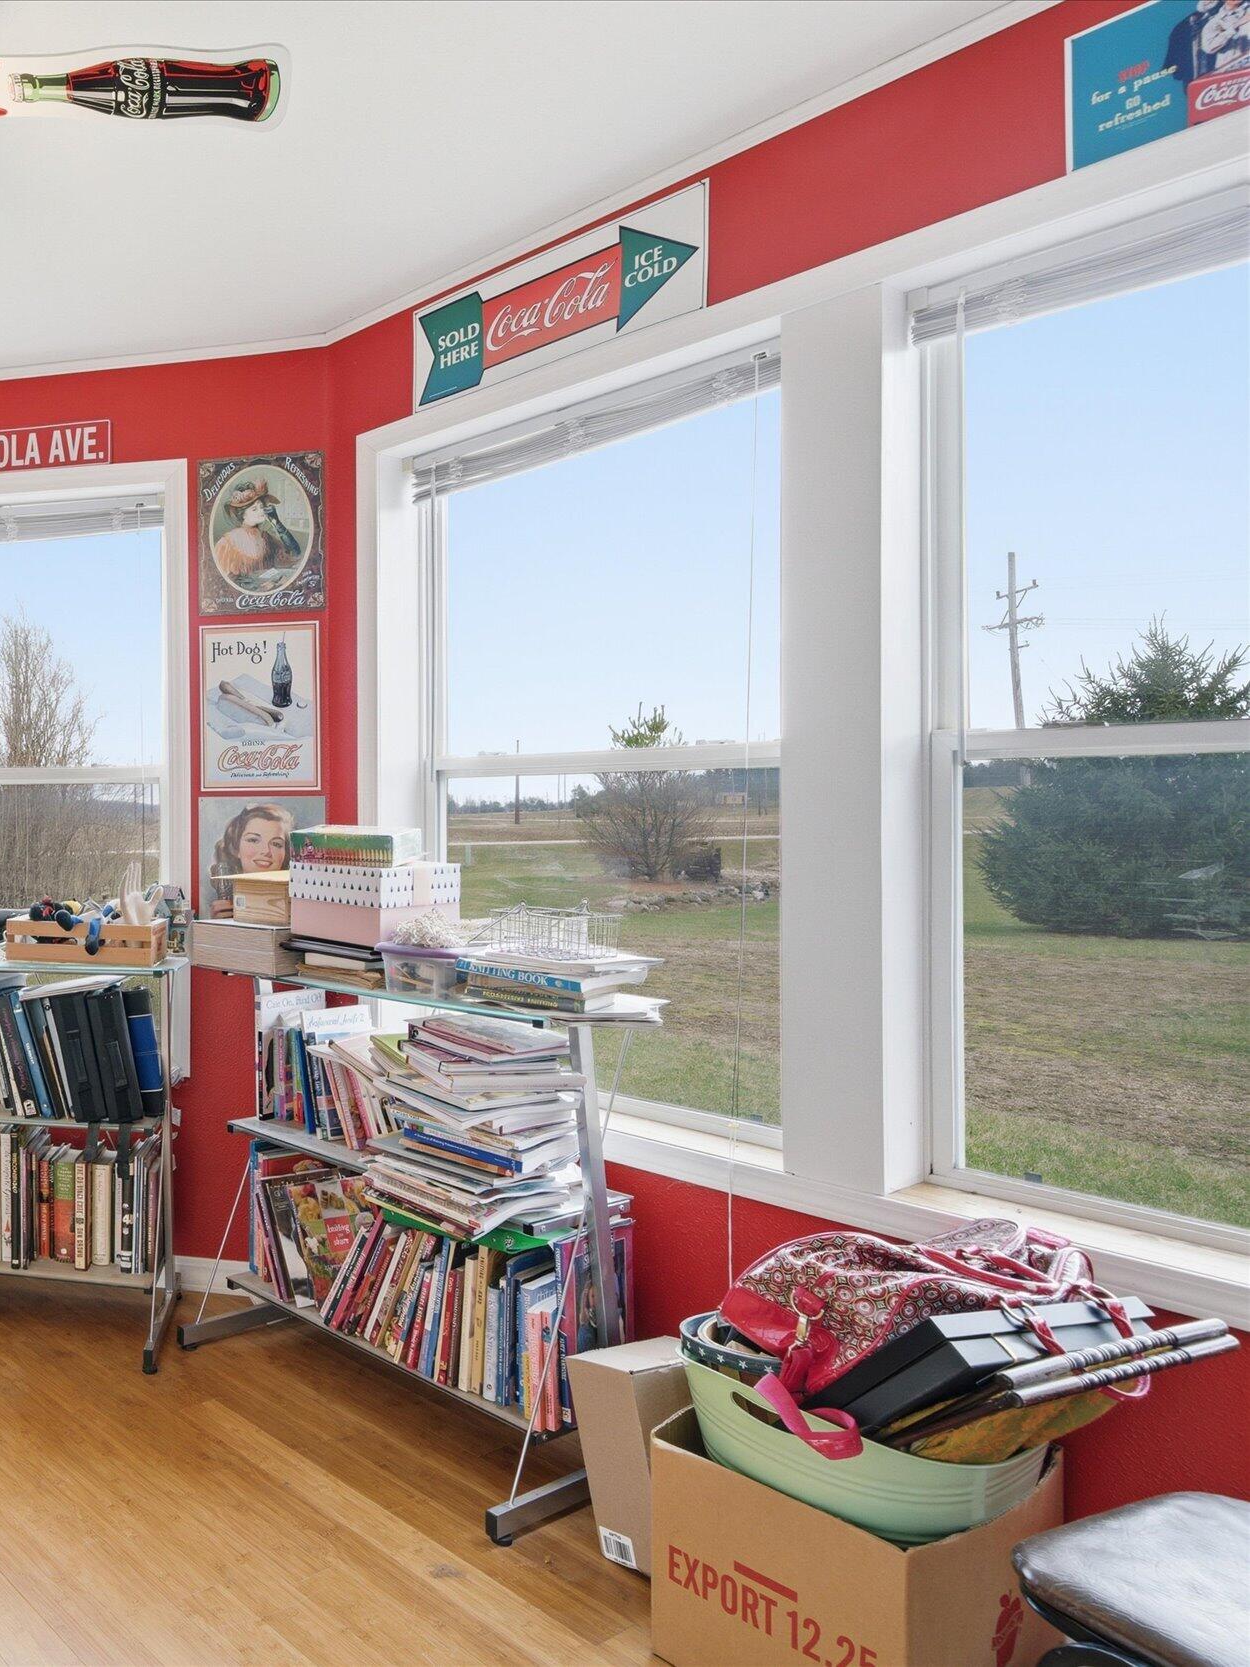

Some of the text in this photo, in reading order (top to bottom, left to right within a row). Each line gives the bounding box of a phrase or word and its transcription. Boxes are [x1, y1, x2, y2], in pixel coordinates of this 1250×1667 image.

[1133, 65, 1177, 92] pause
[1098, 94, 1171, 131] refreshed
[624, 257, 678, 289] COLD
[634, 246, 663, 271] ICE
[486, 257, 619, 352] Coca-Cola
[438, 323, 480, 352] SOLD
[440, 341, 480, 369] HERE
[49, 426, 104, 463] AVE.
[211, 640, 267, 664] Hot Dog!
[518, 970, 548, 986] BOOK
[668, 1544, 778, 1637] EXPORT
